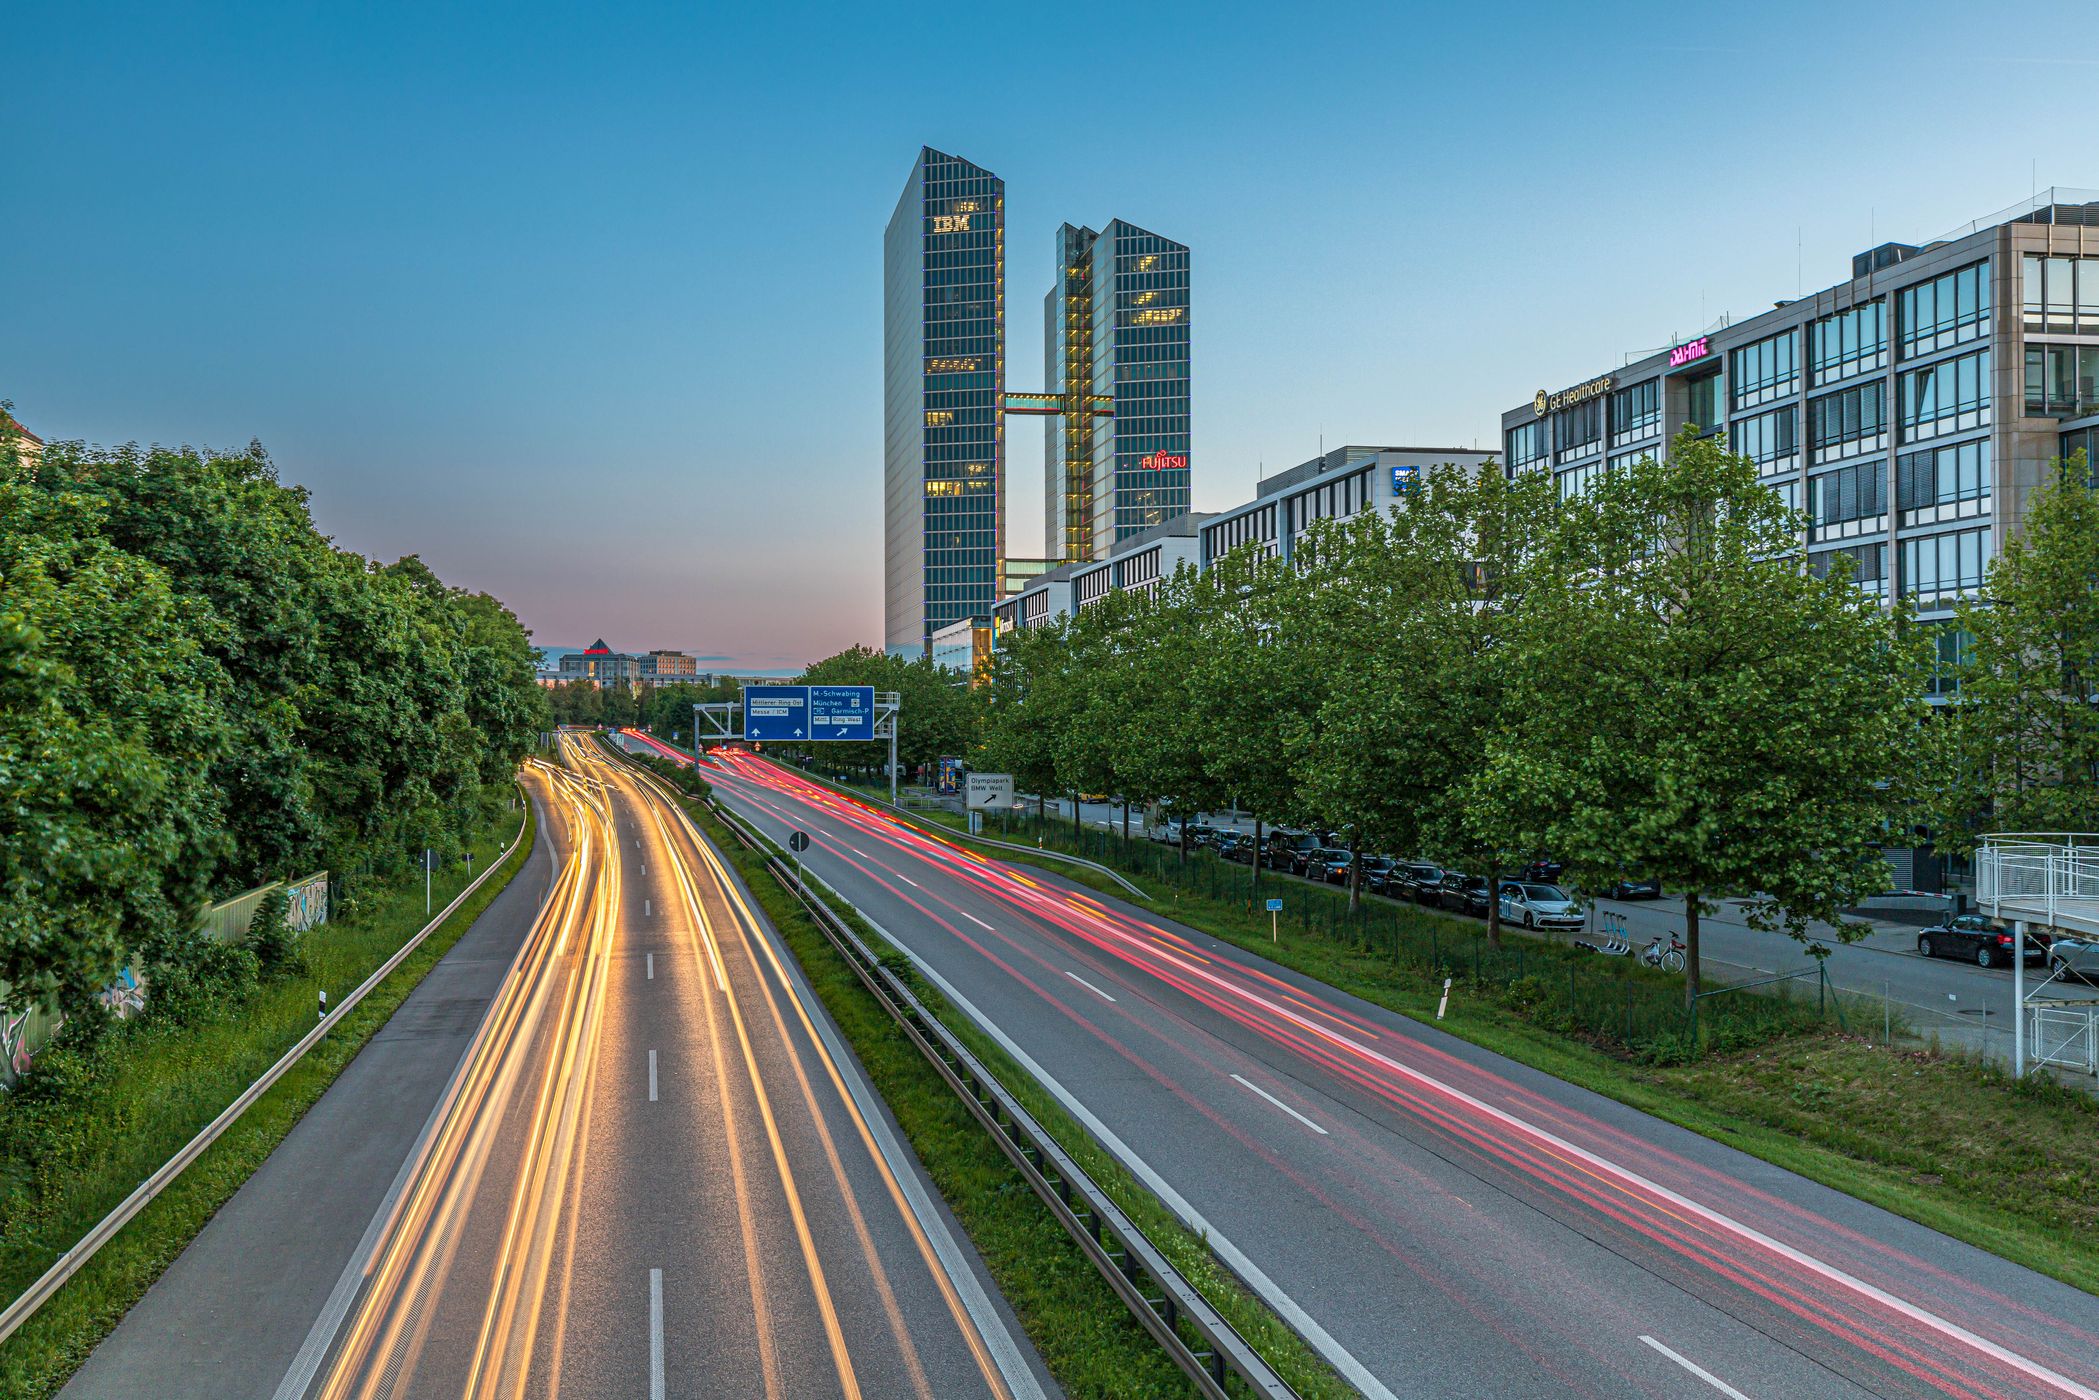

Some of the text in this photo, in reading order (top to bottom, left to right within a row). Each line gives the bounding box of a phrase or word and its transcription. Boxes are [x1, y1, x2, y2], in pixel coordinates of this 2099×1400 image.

[934, 214, 970, 233] IBM
[1549, 378, 1610, 410] GE Healthcare
[1142, 449, 1187, 471] FUJITSU
[813, 690, 861, 698] M.-Schwabing
[778, 699, 791, 707] Ring
[831, 707, 870, 715] Garmisch-P
[832, 716, 845, 724] Ring
